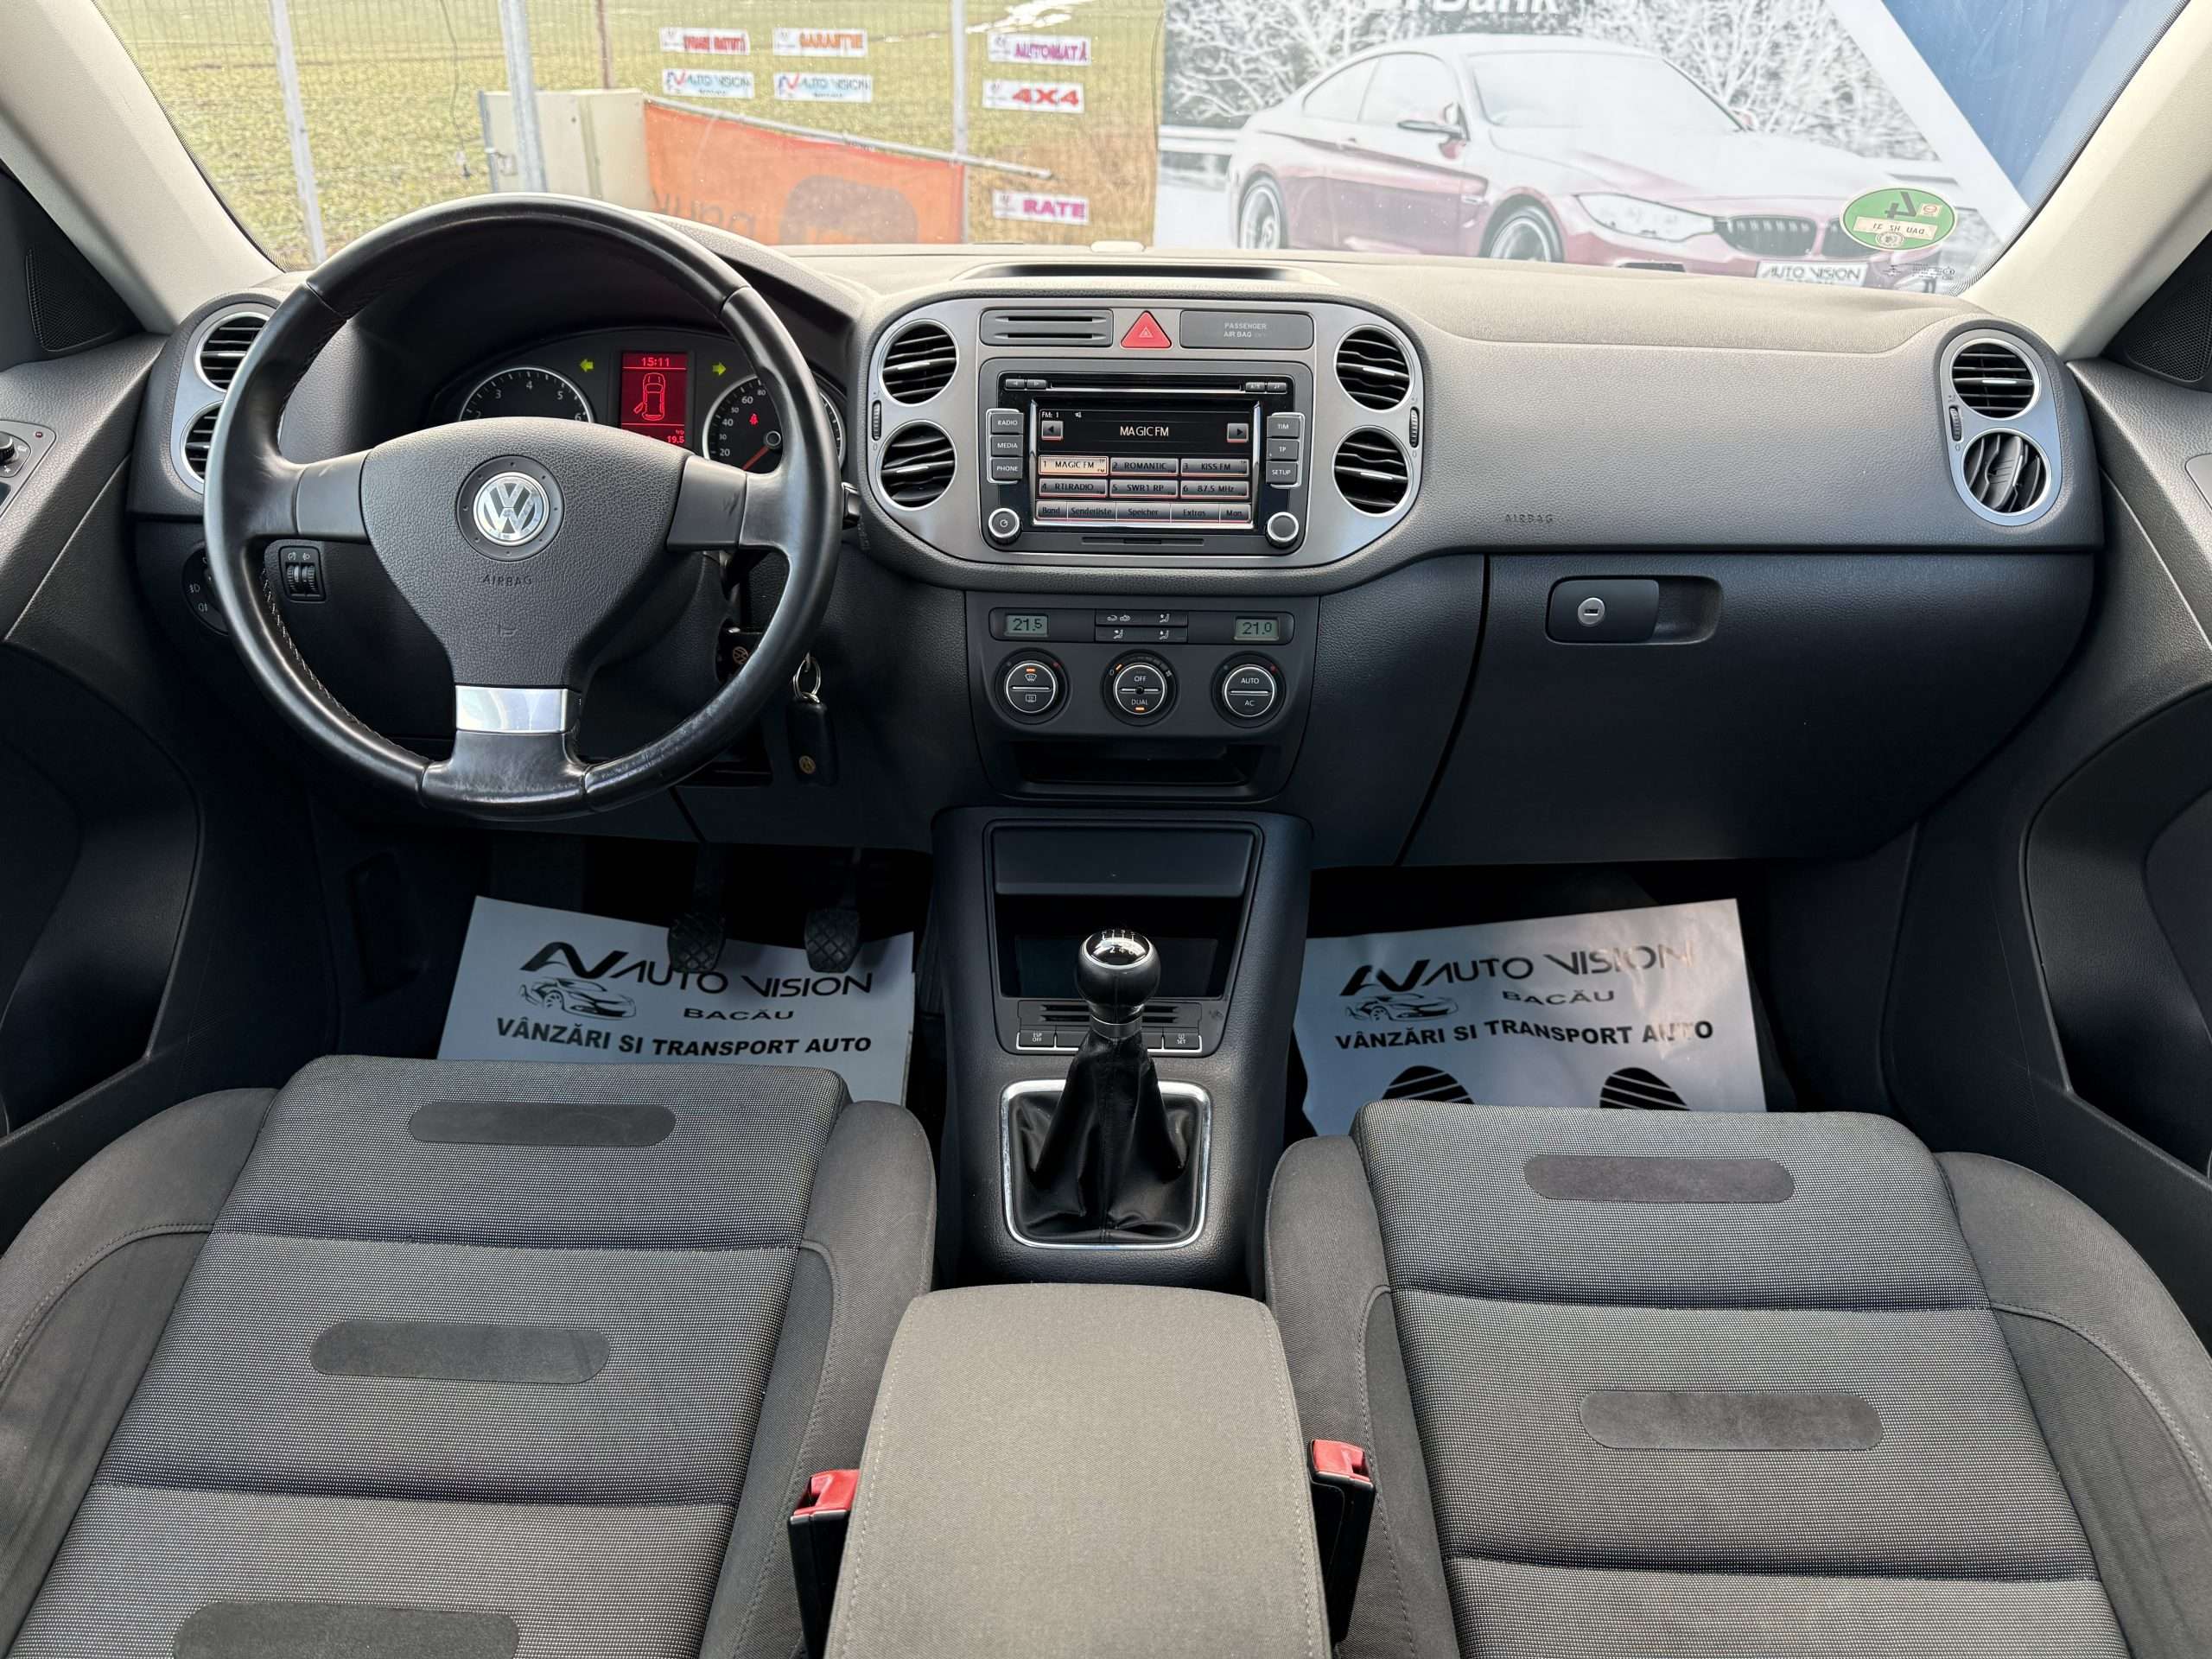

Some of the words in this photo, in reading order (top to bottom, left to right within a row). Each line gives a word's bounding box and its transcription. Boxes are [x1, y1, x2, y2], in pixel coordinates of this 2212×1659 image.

[1023, 198, 1085, 219] RATE
[1762, 265, 1805, 278] AUTO
[1809, 266, 1861, 281] VISION
[641, 357, 670, 367] 15:11
[526, 380, 533, 390] 4
[495, 389, 502, 399] 3
[557, 391, 563, 400] 5
[741, 396, 753, 404] 60
[721, 418, 734, 427] 40
[1120, 426, 1154, 436] MAGIC
[1154, 426, 1169, 436] FM
[720, 448, 730, 457] 20
[1201, 462, 1217, 471] KISS
[1219, 462, 1231, 471] FM
[1505, 513, 1554, 524] AIRBAG
[482, 574, 532, 587] AIRBAG
[1012, 618, 1043, 632] 21.5
[1242, 621, 1272, 635] 21.0
[1421, 957, 1534, 986] AUTO
[1543, 940, 1694, 976] VISION
[608, 960, 728, 995] AUTO
[741, 973, 873, 997] VISION
[496, 1016, 611, 1050] VÂNZĂRI
[618, 1035, 644, 1054] SI
[652, 1038, 800, 1057] TRANSPORT
[804, 1037, 872, 1053] AUTO
[1335, 1026, 1445, 1049] VÂNZĂRI
[1453, 1024, 1478, 1042] SI
[1484, 1019, 1632, 1045] TRANSPORT
